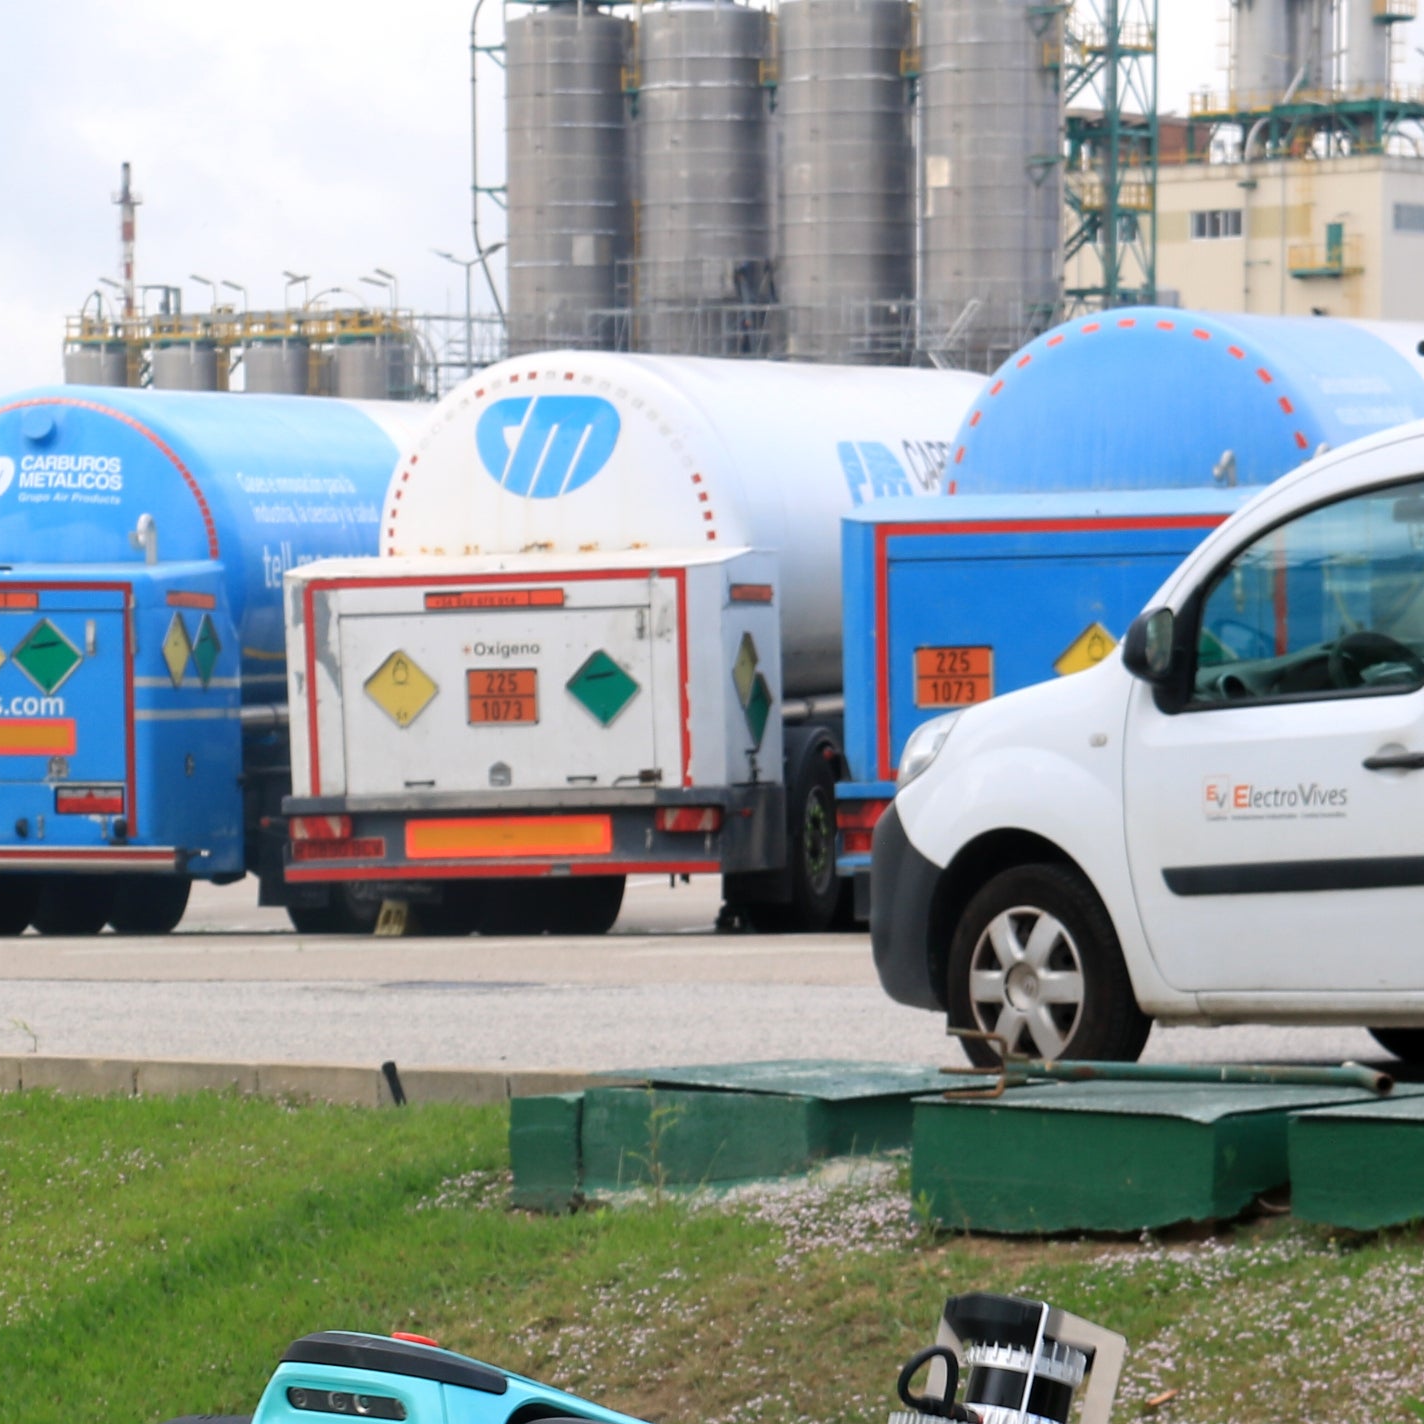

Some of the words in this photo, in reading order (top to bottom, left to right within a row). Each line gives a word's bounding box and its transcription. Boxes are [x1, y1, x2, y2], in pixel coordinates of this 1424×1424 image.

[20, 455, 121, 473] CARBUROS
[19, 472, 123, 491] METALICOS
[54, 493, 68, 502] Air
[936, 650, 971, 673] 225
[486, 673, 518, 693] 225
[931, 681, 976, 703] 1073
[482, 701, 523, 720] 1073
[1233, 783, 1348, 809] ElectroVives
